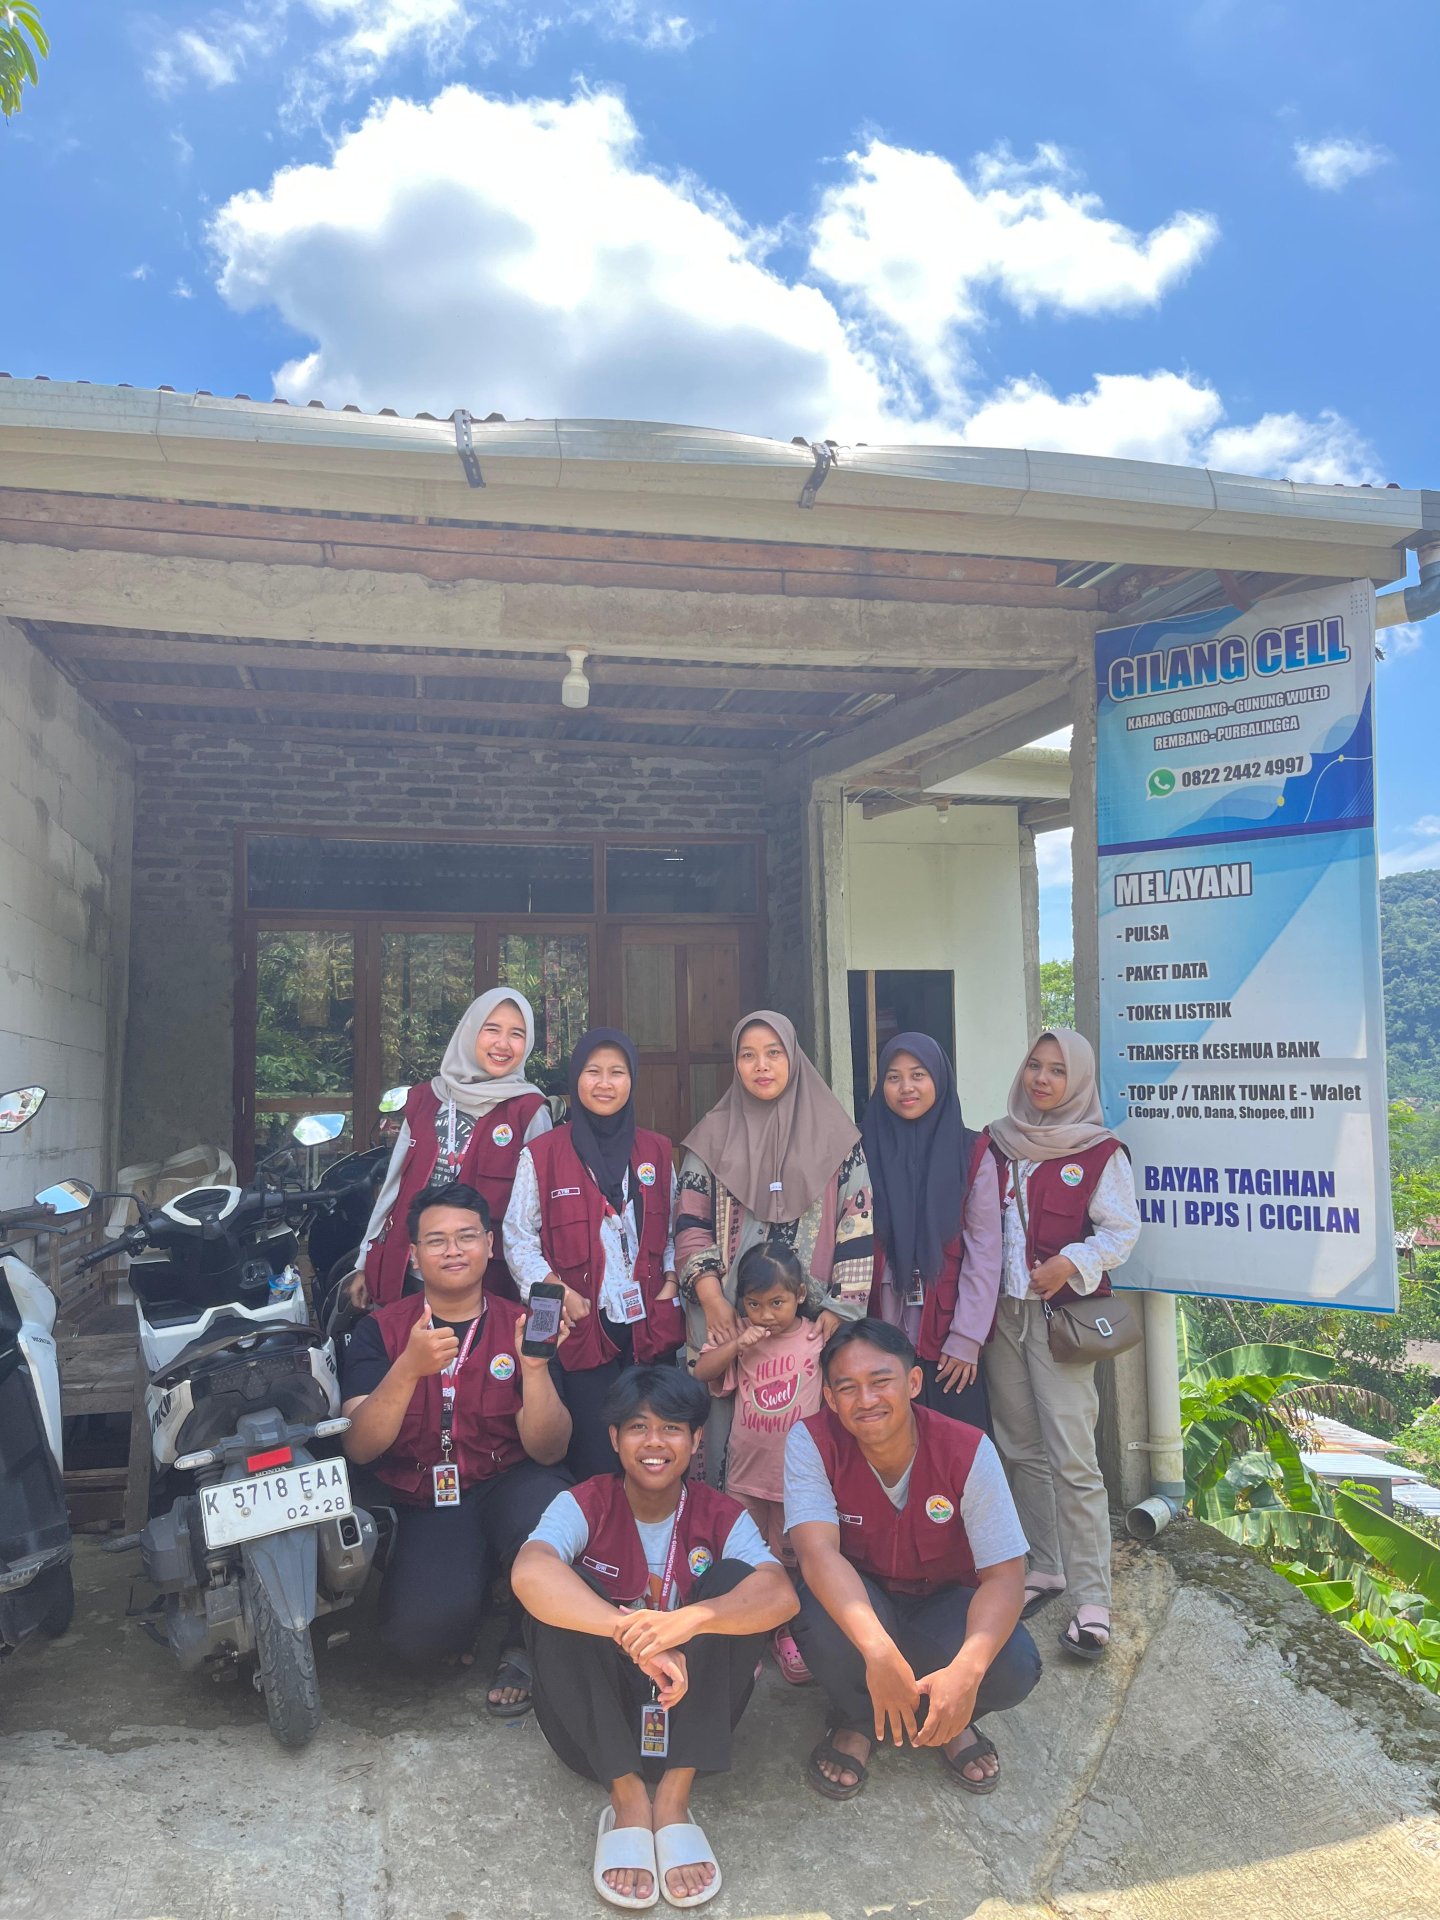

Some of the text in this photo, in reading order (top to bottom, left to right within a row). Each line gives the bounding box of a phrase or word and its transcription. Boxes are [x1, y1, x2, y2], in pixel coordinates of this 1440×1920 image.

[1110, 616, 1349, 701] GILANG CELL
[1127, 711, 1172, 731] KARANG
[1173, 702, 1228, 723] GONDANG
[1235, 692, 1285, 713] GUNUNG
[1286, 685, 1330, 706] WULED
[1154, 730, 1209, 751] REMBANG
[1216, 716, 1300, 741] PURBALINGGA
[1182, 756, 1304, 787] 0822 2442 4997
[1115, 862, 1252, 907] MELAYANI
[1125, 925, 1169, 942] PULSA
[1126, 964, 1168, 981] PAKET
[1172, 962, 1208, 979] DATA
[1126, 1004, 1171, 1021] TOKEN
[1175, 1002, 1232, 1020] LISTRIK
[1127, 1044, 1199, 1060] TRANSFER
[1202, 1042, 1274, 1059] KESEMUA
[1276, 1041, 1320, 1058] BANK
[1128, 1085, 1155, 1101] TOP
[1158, 1085, 1178, 1100] UP
[1181, 1085, 1189, 1101] /
[1191, 1085, 1236, 1101] TARIK
[1239, 1084, 1285, 1101] TUNAI
[1289, 1084, 1297, 1100] E
[1310, 1084, 1361, 1101] Walet
[1135, 1106, 1169, 1119] Gopay
[1176, 1106, 1202, 1119] OVO,
[1204, 1106, 1237, 1119] Dana,
[1239, 1106, 1288, 1120] Shopee,
[1145, 1165, 1335, 1198] BAYAR TAGIHAN
[1184, 1200, 1240, 1228] BPJS
[1259, 1203, 1360, 1234] CICILAN
[756, 1354, 796, 1382] HELLO
[761, 1381, 791, 1408] Sweet
[255, 1466, 287, 1478] HONDA
[205, 1465, 342, 1516] K 5718 EAA
